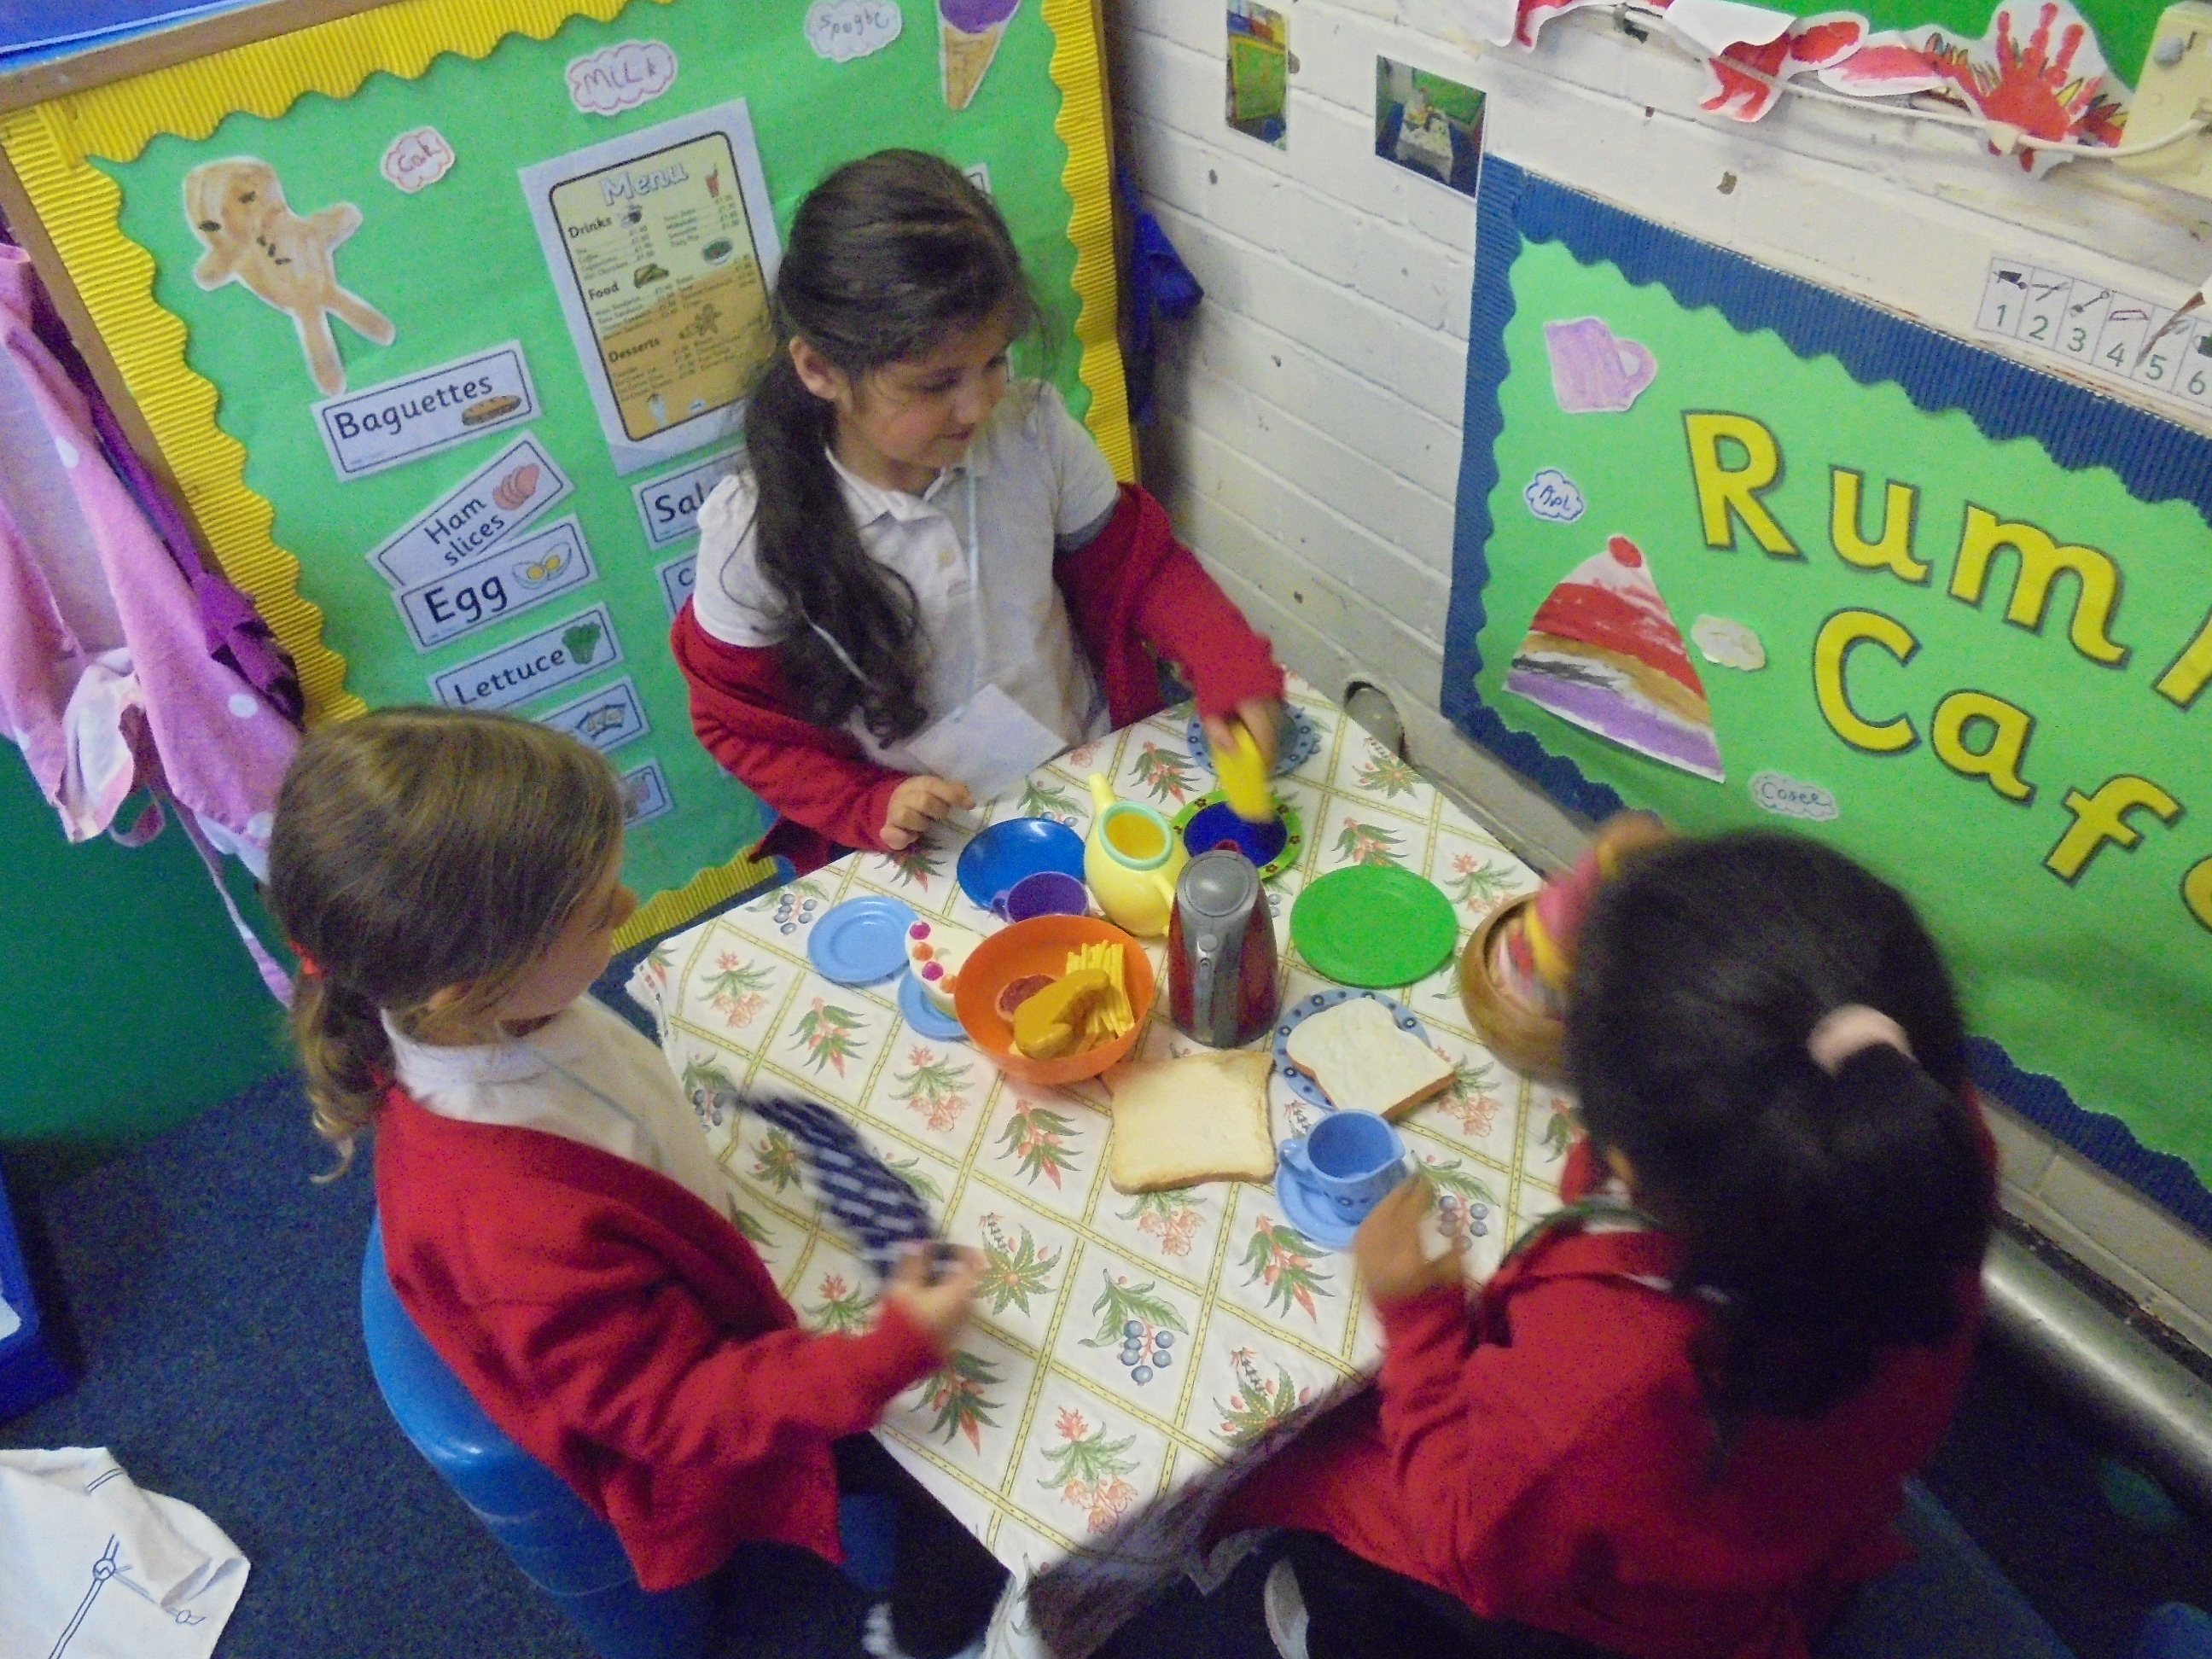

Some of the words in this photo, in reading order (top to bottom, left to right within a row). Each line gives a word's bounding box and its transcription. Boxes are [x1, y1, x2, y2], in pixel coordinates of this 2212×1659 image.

[600, 162, 690, 207] Menu
[568, 216, 612, 238] Drinks
[589, 281, 620, 300] Food
[608, 337, 661, 363] Desserts
[1996, 304, 2006, 327] 1
[2029, 315, 2049, 341] 2
[2067, 327, 2087, 352] 3
[2106, 342, 2124, 367] 4
[2145, 353, 2168, 381] 5
[2187, 370, 2206, 395] 6
[334, 375, 493, 439] Baguettes
[423, 498, 487, 544] Ham
[655, 482, 718, 523] Sal
[445, 515, 505, 566] slices
[424, 575, 508, 624] Egg
[454, 649, 566, 705] Lettuce
